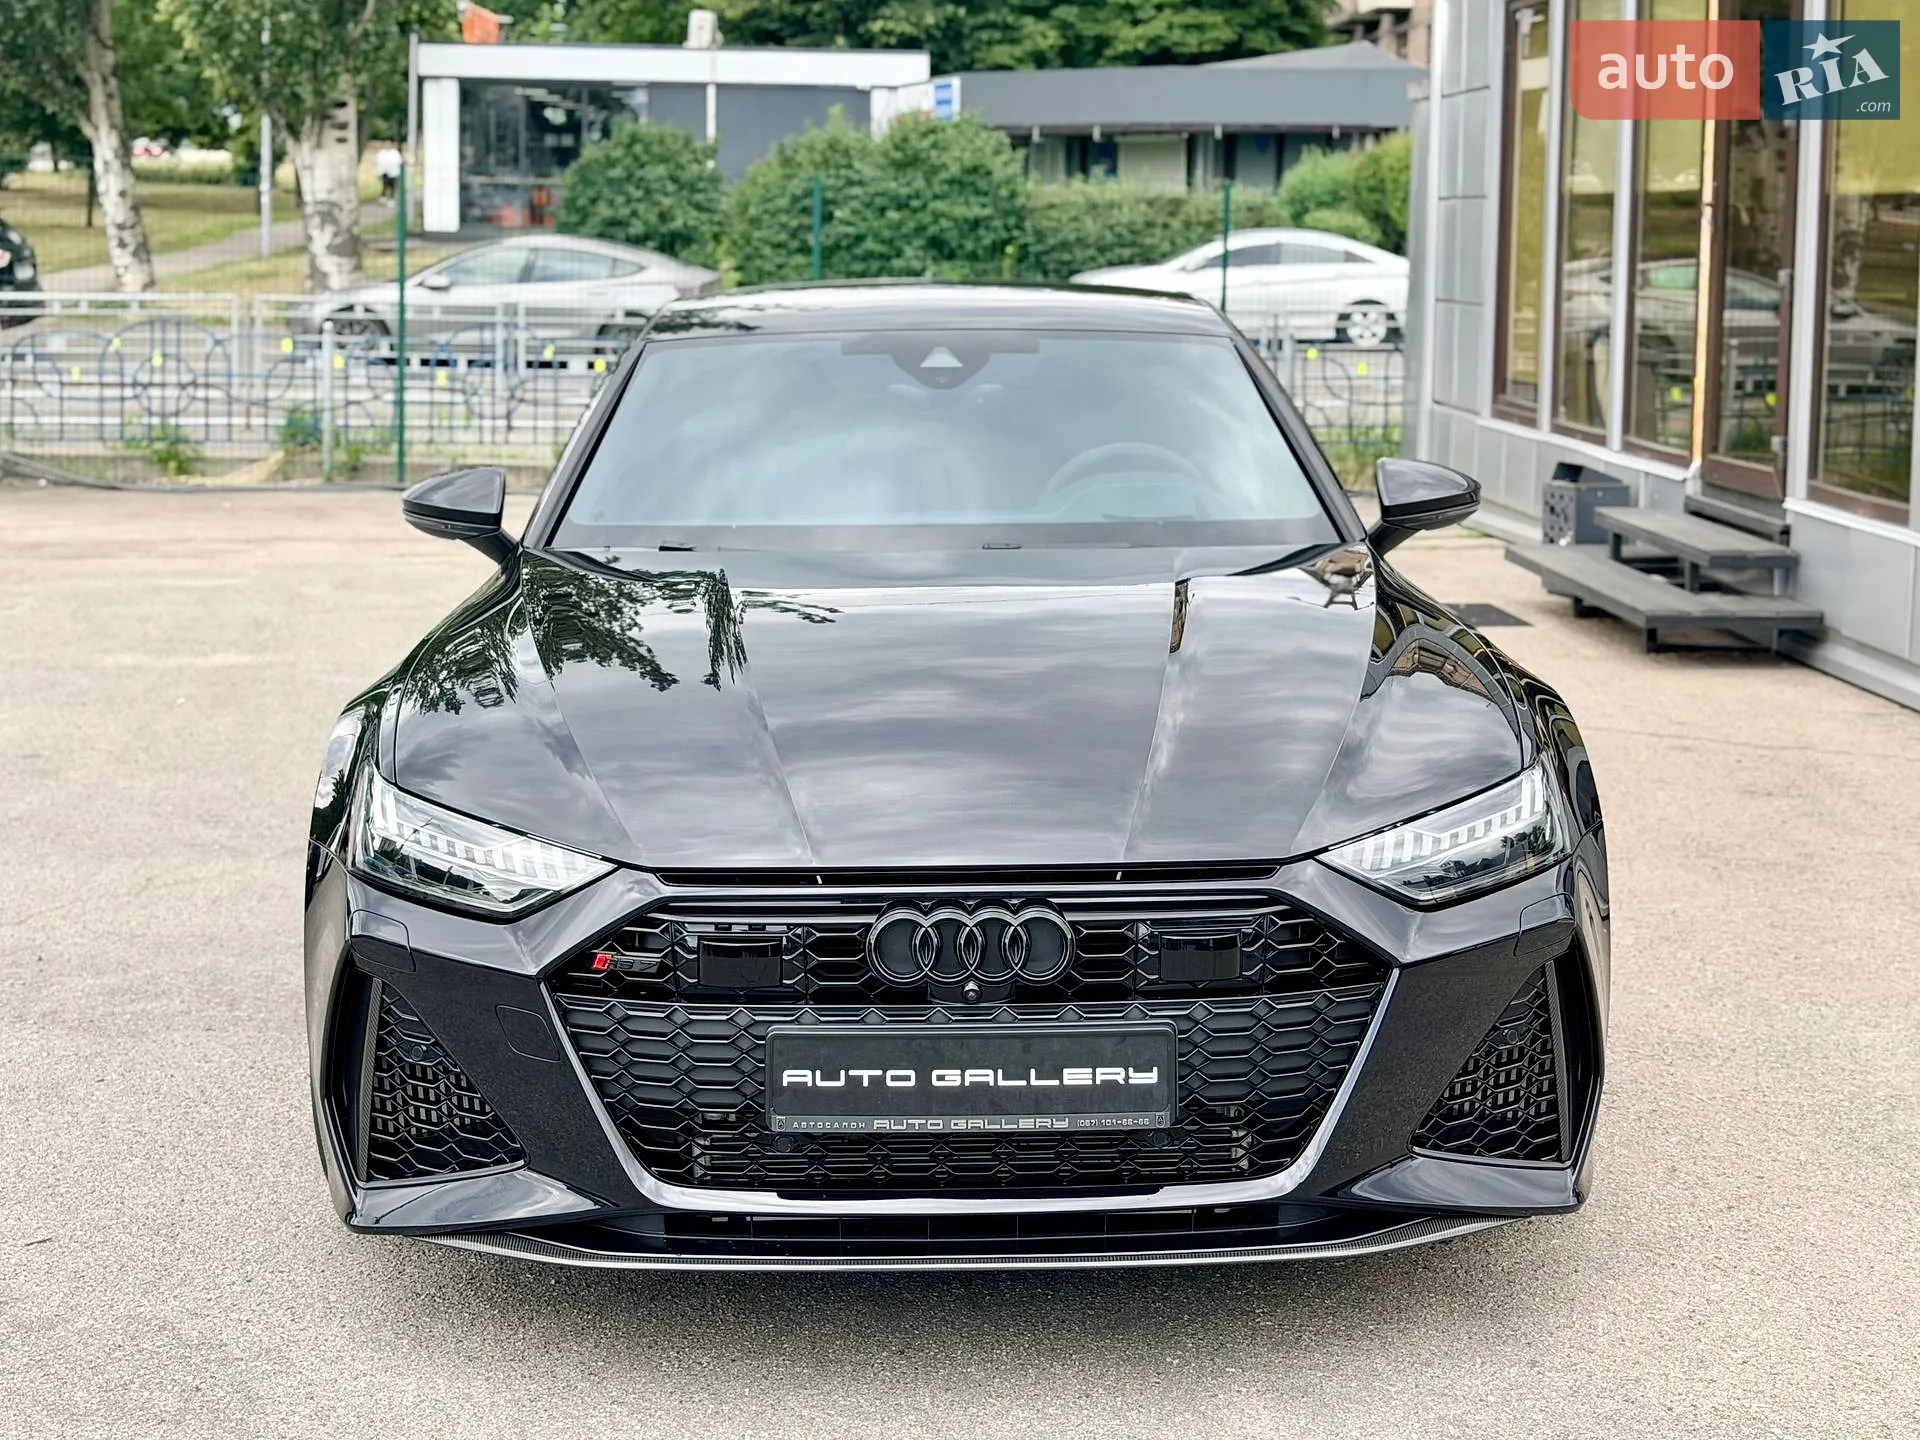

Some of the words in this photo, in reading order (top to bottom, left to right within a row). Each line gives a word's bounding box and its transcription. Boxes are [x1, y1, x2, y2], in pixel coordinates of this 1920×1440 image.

[782, 1069, 916, 1087] AUTO
[931, 1066, 1158, 1086] GALLERY
[873, 1119, 944, 1130] AUTO
[950, 1117, 1069, 1130] GALLERY
